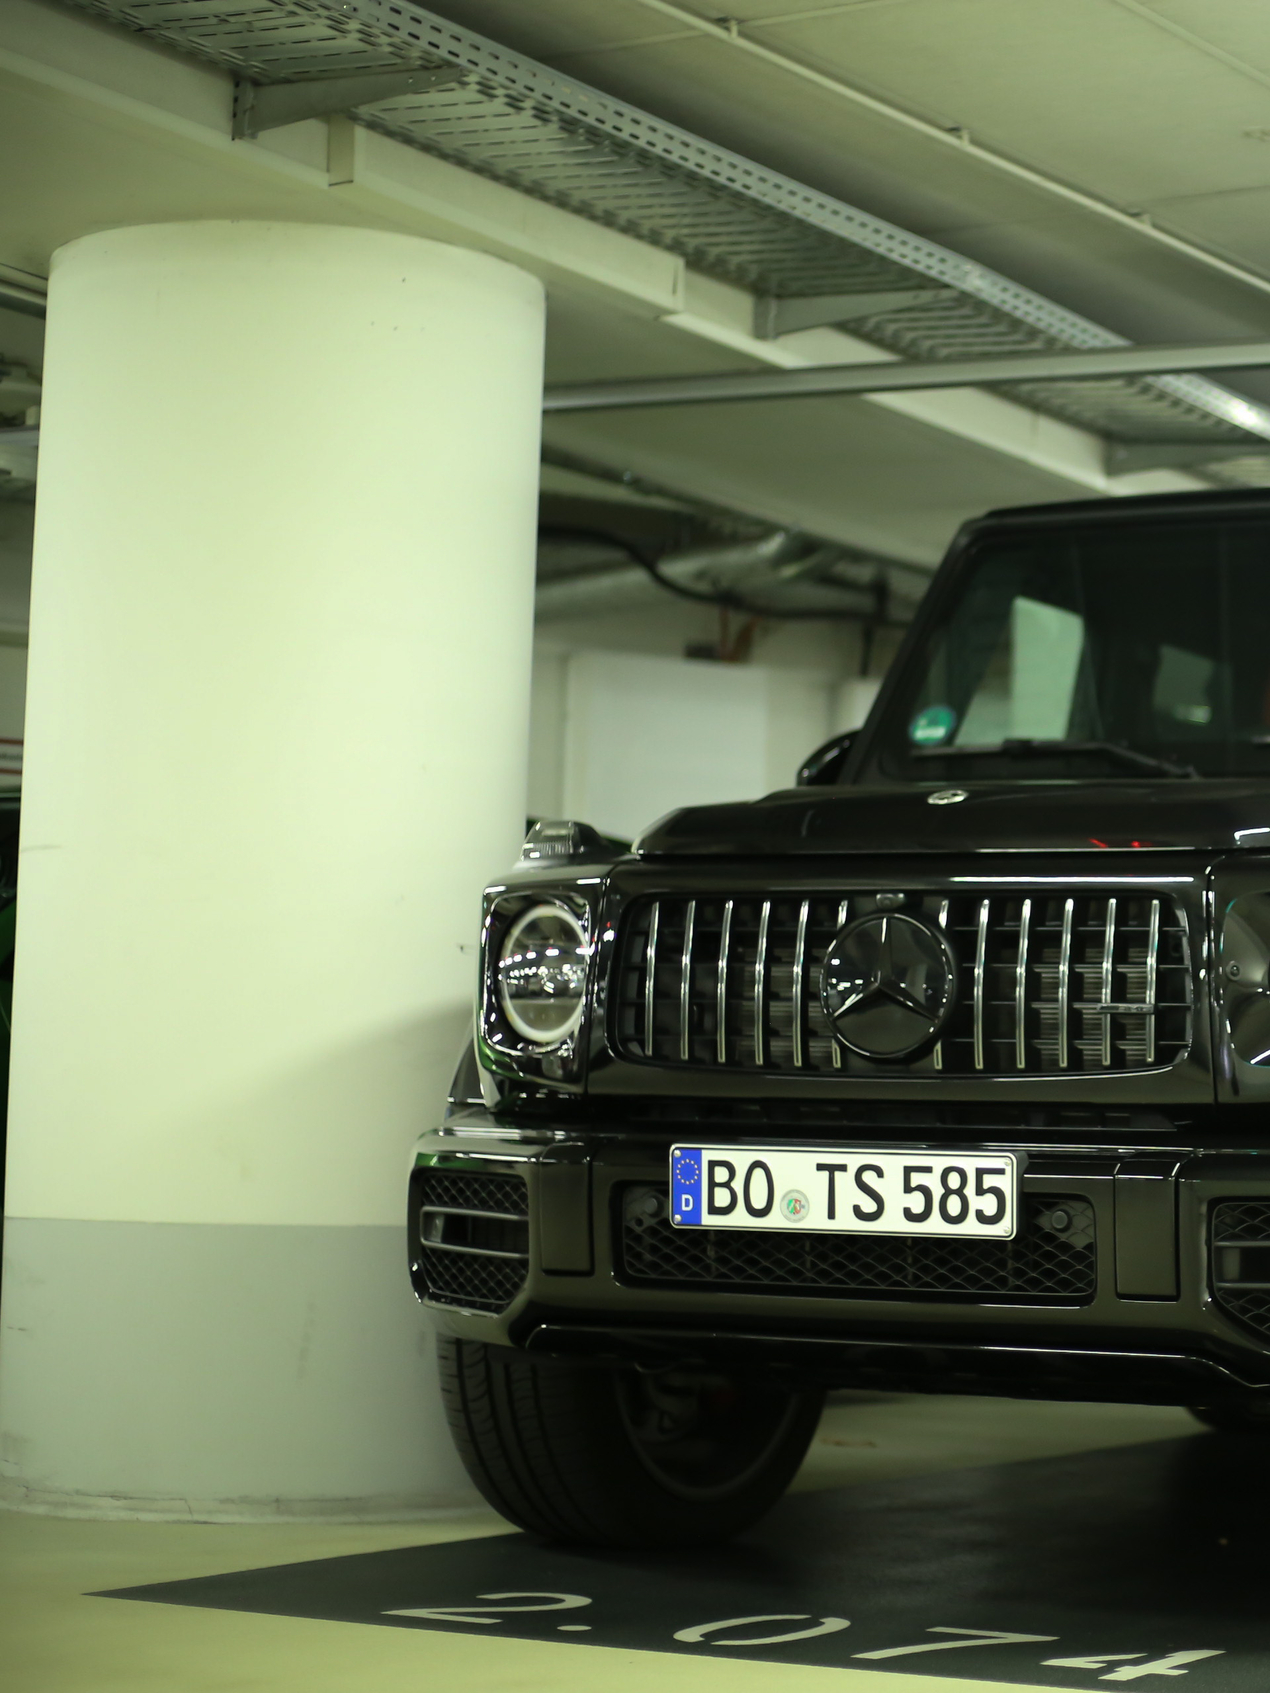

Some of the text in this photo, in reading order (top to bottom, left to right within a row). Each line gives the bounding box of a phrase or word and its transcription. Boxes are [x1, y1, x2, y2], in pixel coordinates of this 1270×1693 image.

[681, 1193, 694, 1212] D
[707, 1159, 1007, 1225] BO TS 585
